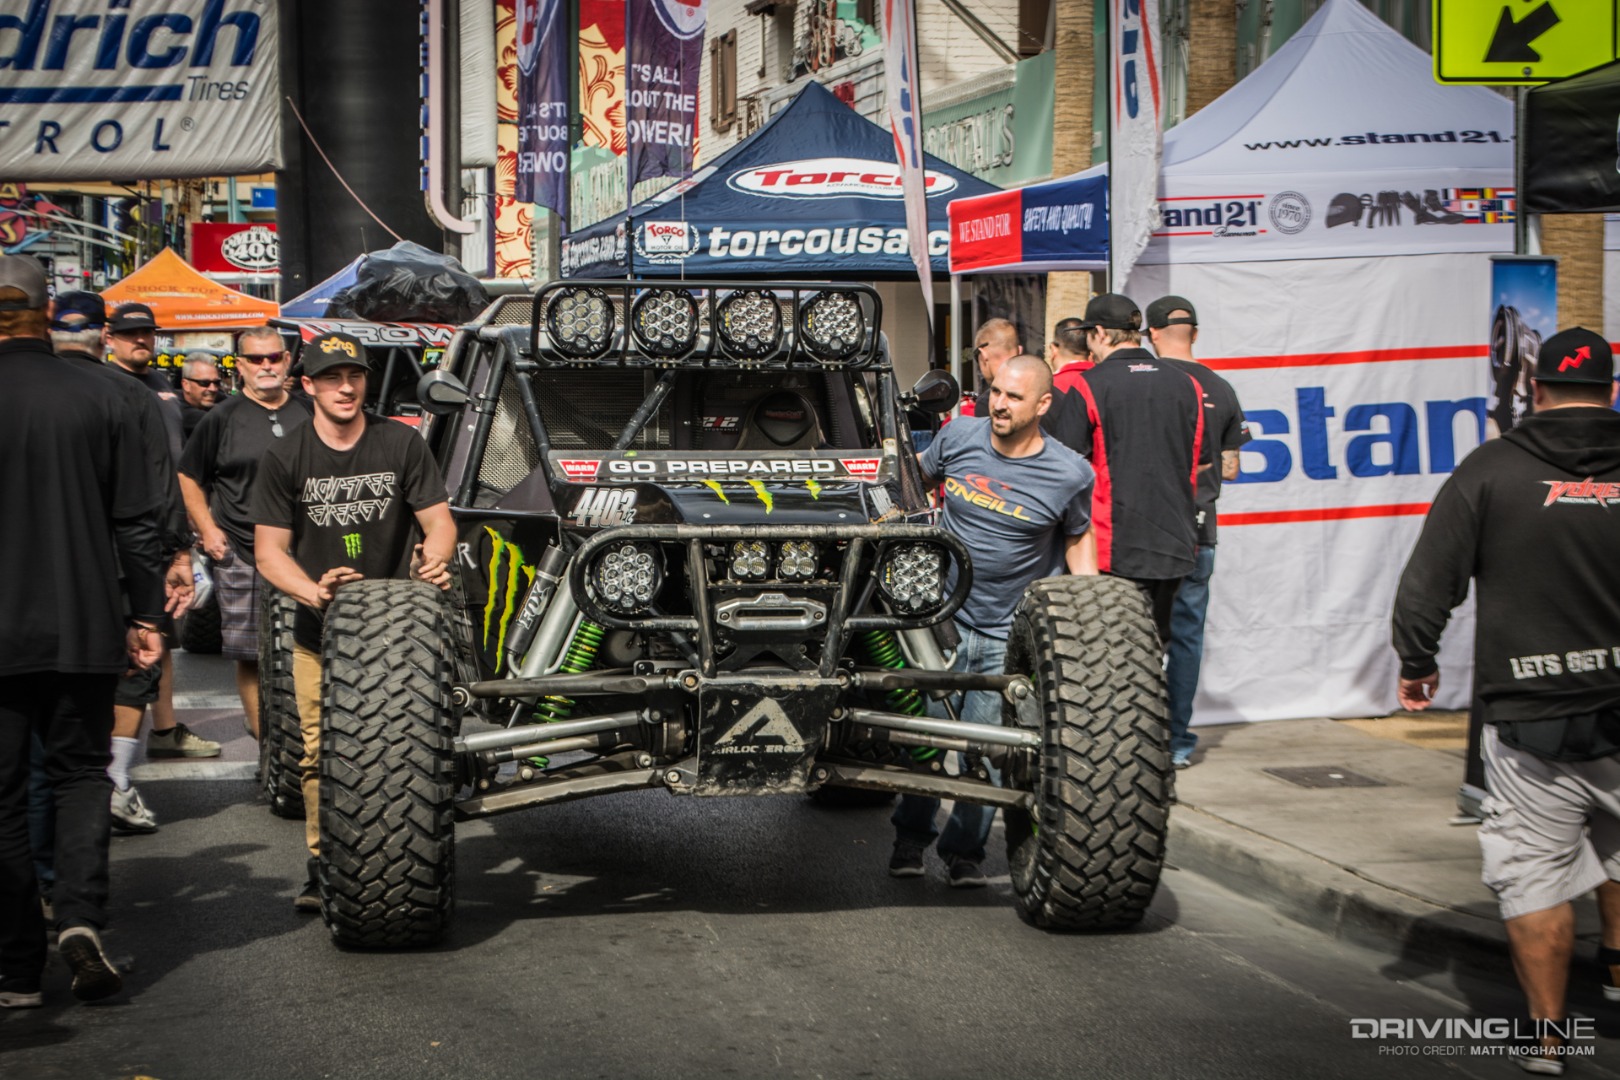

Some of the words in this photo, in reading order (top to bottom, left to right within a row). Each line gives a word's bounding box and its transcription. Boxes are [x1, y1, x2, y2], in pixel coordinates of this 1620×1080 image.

[652, 65, 680, 85] ALL
[188, 76, 249, 100] Tires
[663, 92, 696, 112] THE
[0, 118, 171, 154] ROL
[1244, 130, 1516, 151] www.stand21.
[1160, 201, 1257, 227] and21
[1277, 208, 1301, 223] 1970
[647, 224, 685, 238] TORCO
[995, 213, 1011, 237] FOR
[1222, 386, 1488, 484] stan
[565, 464, 595, 473] WARN
[609, 460, 656, 473] GO
[667, 460, 835, 473] PREPARED
[848, 463, 876, 471] WARN
[518, 580, 547, 631] FOX
[1509, 653, 1563, 680] LETS
[1565, 648, 1609, 673] GET
